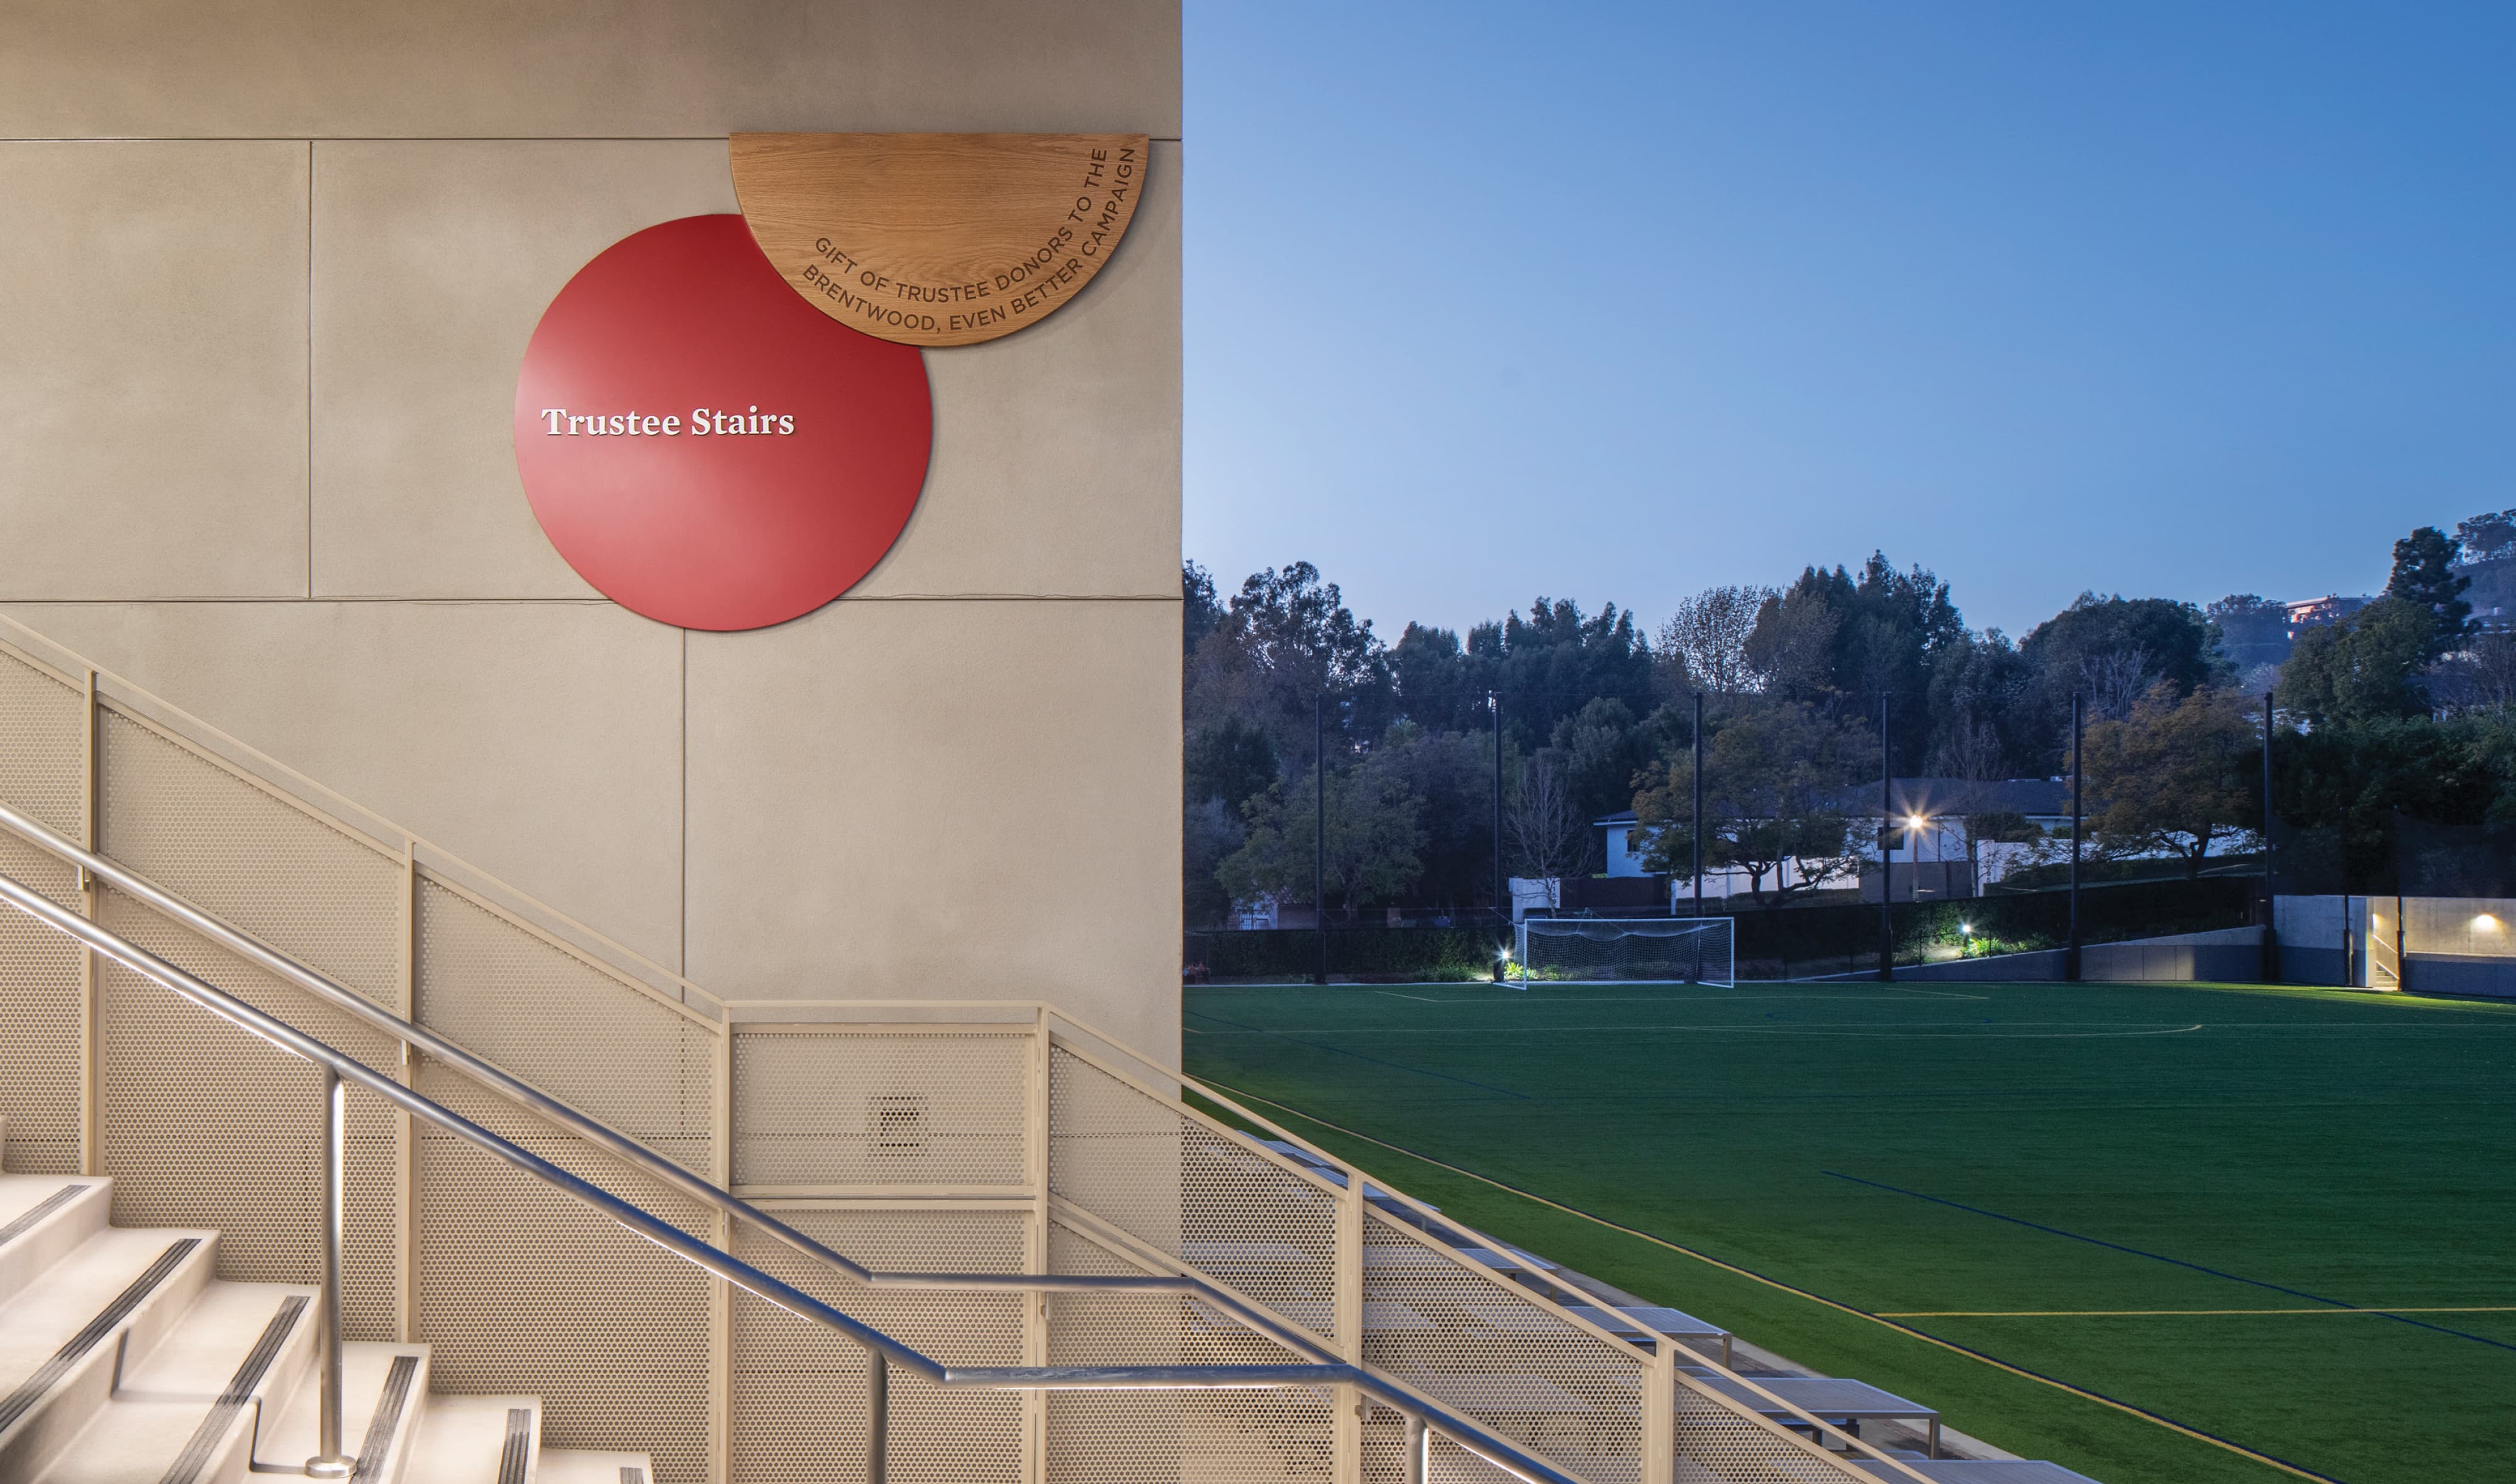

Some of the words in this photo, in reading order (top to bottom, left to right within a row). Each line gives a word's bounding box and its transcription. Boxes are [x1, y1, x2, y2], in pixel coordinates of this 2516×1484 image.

[803, 264, 941, 333] BRENTWOOD,
[950, 305, 1006, 330] EVEN
[1011, 257, 1083, 314] BETTER
[1081, 148, 1135, 257] CAMPAIGN
[815, 237, 857, 275] GIFT
[860, 270, 889, 293] OF
[896, 280, 990, 303] TRUSTEE
[996, 226, 1073, 291] DONORS
[1068, 196, 1092, 224] TO
[1084, 148, 1107, 191] THE
[541, 408, 680, 436] Trustee
[692, 405, 795, 436] Stairs
